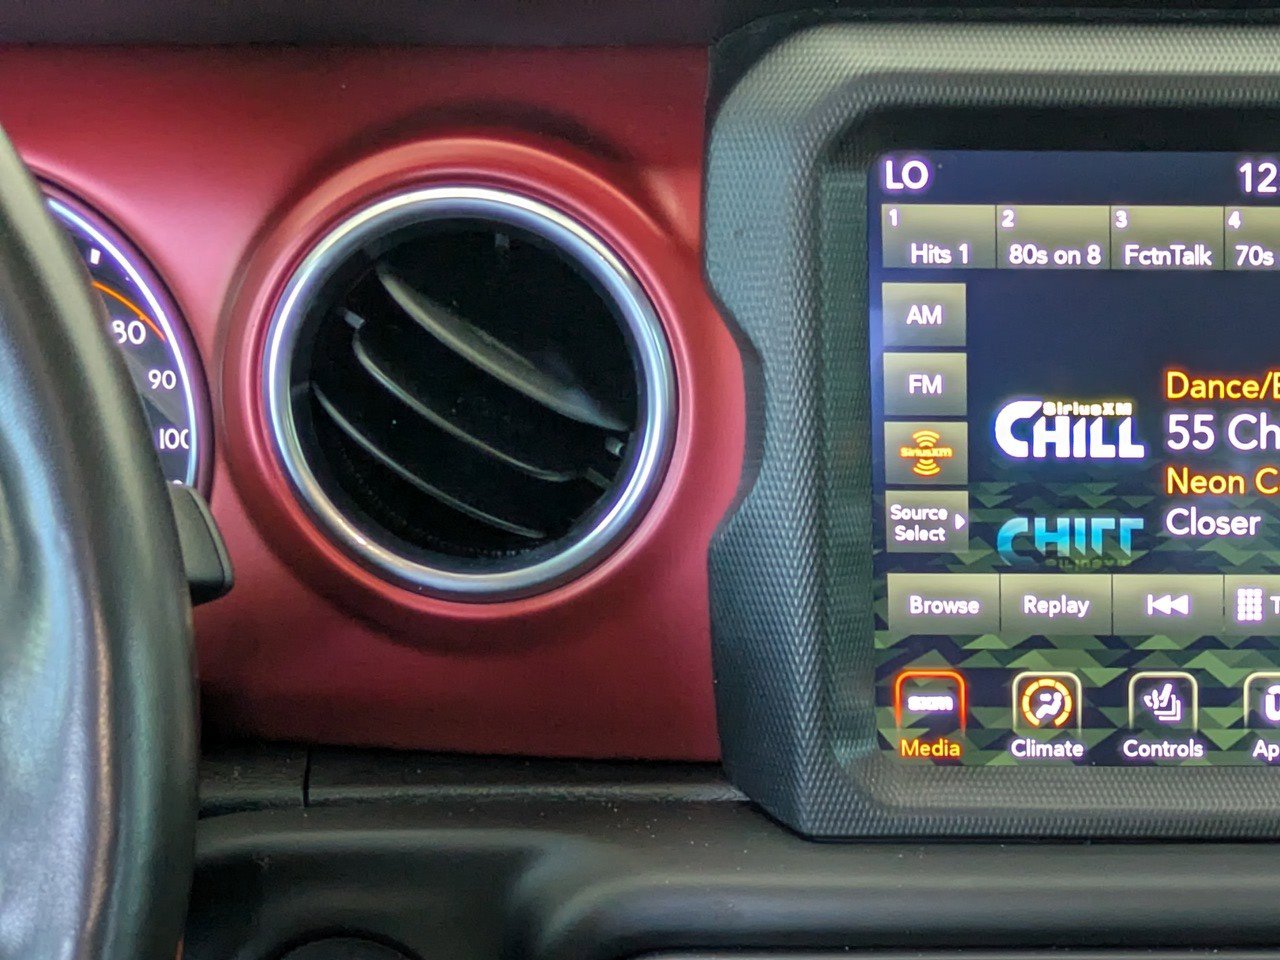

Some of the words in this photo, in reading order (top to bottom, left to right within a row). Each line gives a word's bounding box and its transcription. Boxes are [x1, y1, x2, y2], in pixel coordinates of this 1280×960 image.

[886, 160, 929, 190] LO
[889, 209, 899, 227] 1
[1001, 210, 1015, 228] 2
[1115, 211, 1128, 228] 3
[1227, 211, 1242, 229] 4
[911, 243, 951, 264] Hits
[959, 244, 969, 264] 1
[1009, 244, 1048, 265] 80s
[1054, 249, 1081, 265] on
[1087, 245, 1102, 265] 8
[1124, 244, 1212, 266] FctnTalk
[1235, 245, 1275, 266] 70s
[906, 305, 942, 325] AM
[112, 320, 147, 345] 80
[149, 369, 177, 390] 90
[908, 374, 942, 394] FM
[995, 401, 1144, 458] CHILL
[1167, 413, 1215, 450] 55
[1166, 467, 1245, 495] Neon
[890, 504, 948, 521] Source
[1165, 506, 1261, 537] Closer
[894, 525, 946, 542] Select
[909, 595, 980, 615] Browse
[1023, 595, 1090, 618] Replay
[901, 739, 961, 757] Media
[1011, 739, 1084, 758] Climate
[1123, 739, 1204, 758] Controls
